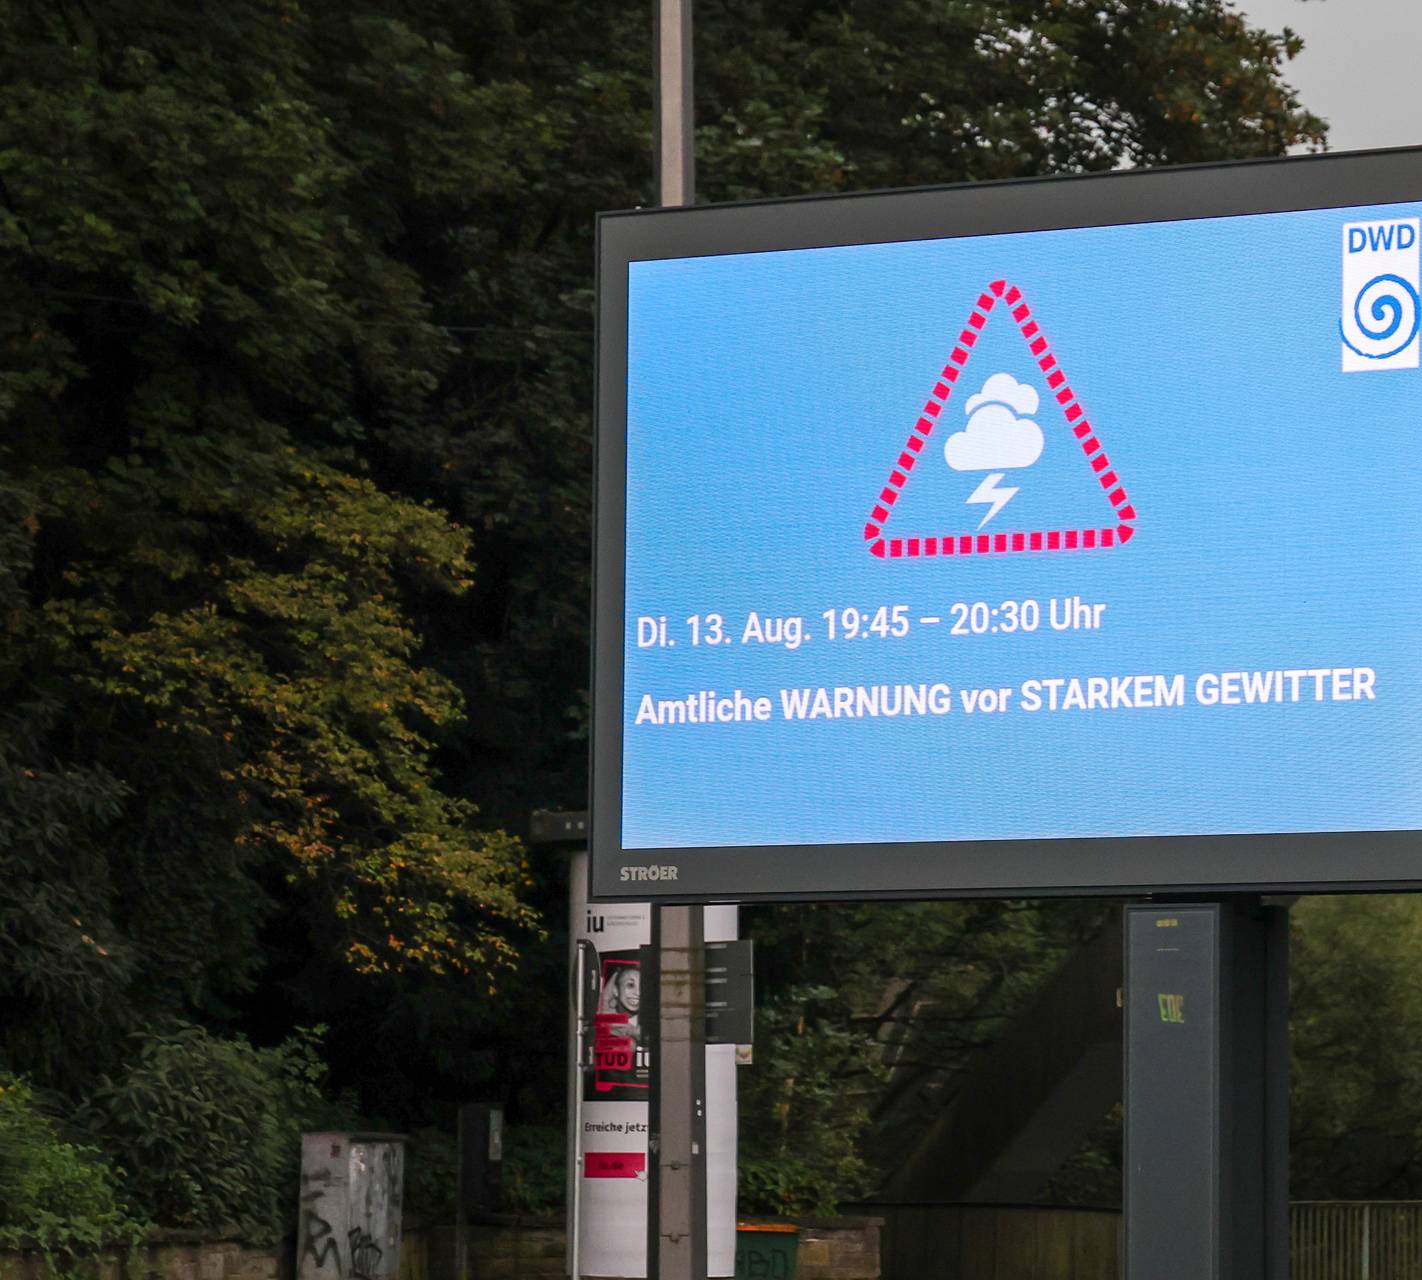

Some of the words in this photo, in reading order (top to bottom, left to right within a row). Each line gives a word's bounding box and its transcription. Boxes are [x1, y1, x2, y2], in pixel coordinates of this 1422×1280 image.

[1348, 224, 1415, 253] DWD
[637, 616, 675, 648] Di.
[686, 613, 732, 646] 13.
[741, 611, 811, 649] Aug.
[823, 606, 910, 640] 19:45
[950, 599, 1039, 635] 20:30
[1050, 596, 1106, 631] Uhr
[635, 690, 772, 725] Amtliche
[780, 683, 951, 719] WARNUNG
[960, 687, 1012, 713] vor
[1020, 673, 1185, 711] STARKEM
[1195, 667, 1377, 705] GEWITTER
[620, 865, 679, 881] STRÖER
[587, 910, 604, 933] iu
[585, 1122, 623, 1132] Erreiche
[625, 1122, 648, 1134] jetz
